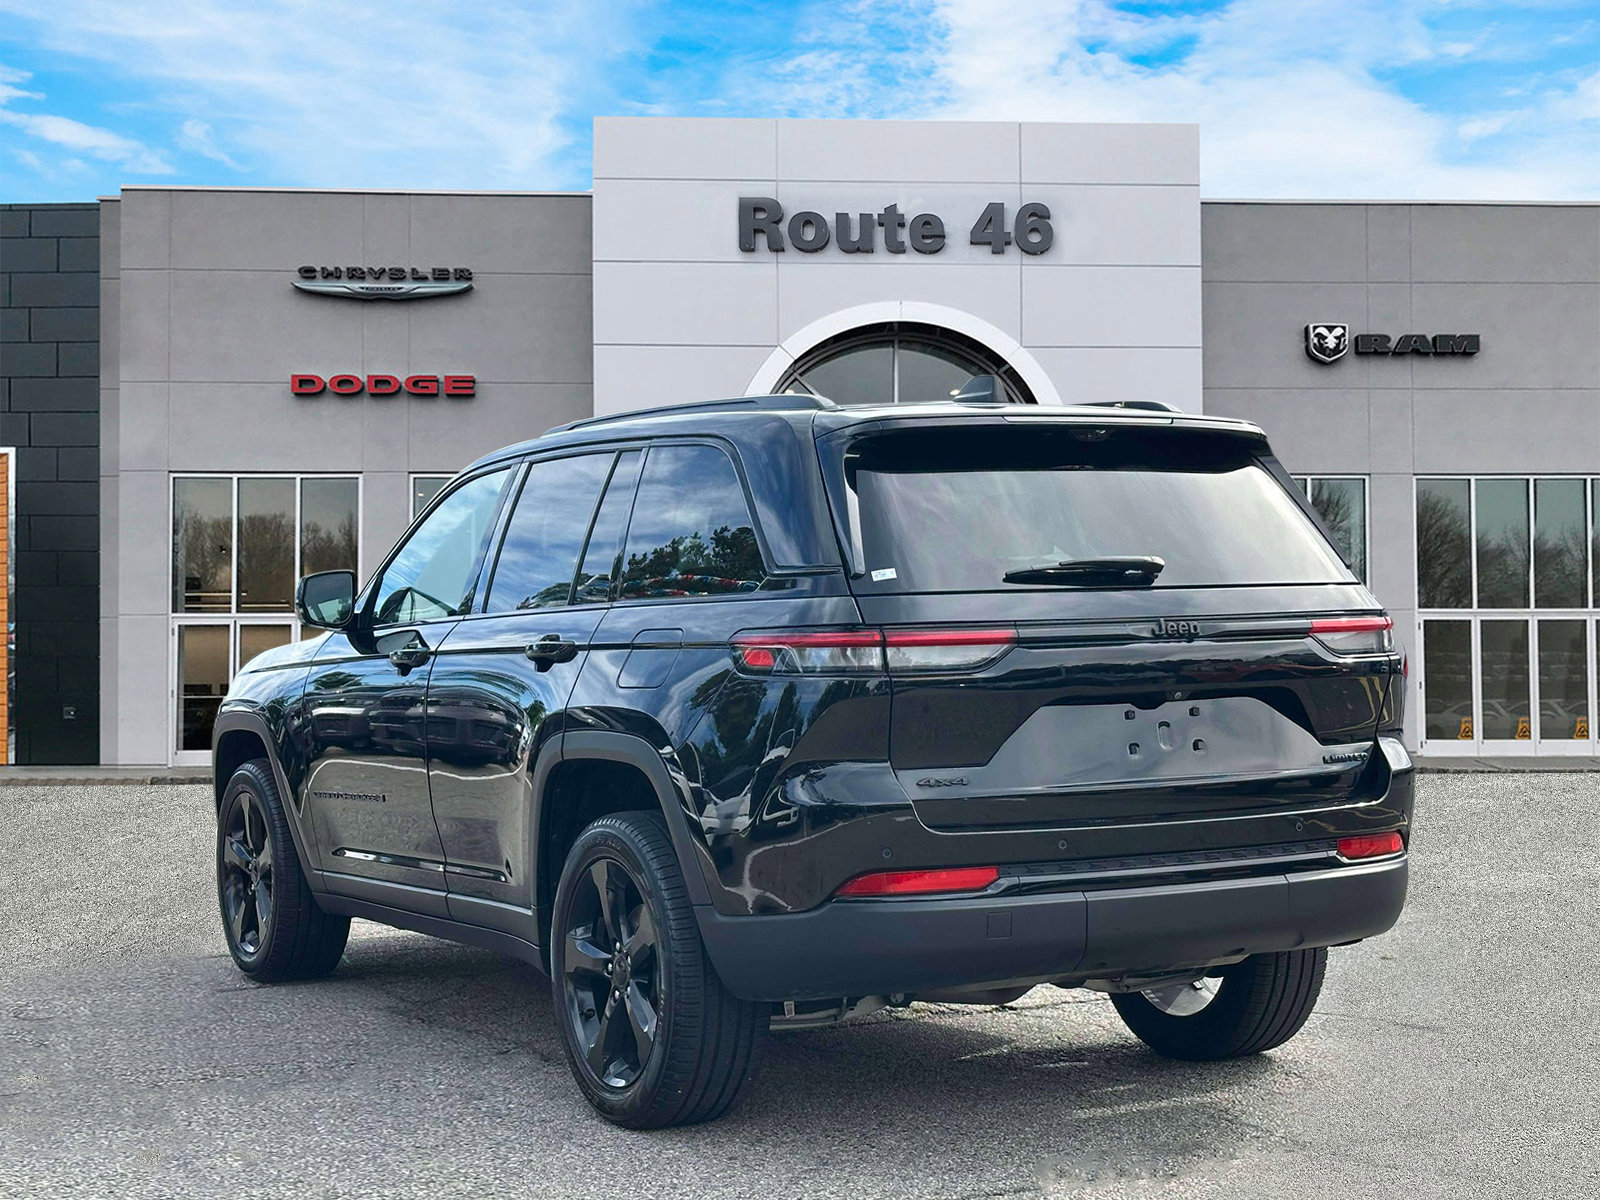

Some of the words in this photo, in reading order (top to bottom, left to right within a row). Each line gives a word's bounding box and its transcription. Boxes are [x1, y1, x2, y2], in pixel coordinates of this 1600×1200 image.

[738, 196, 946, 254] Route
[969, 201, 1054, 256] 46
[298, 266, 473, 281] CHRYSLER
[1354, 333, 1481, 356] RAM
[290, 373, 476, 397] DODGE
[1151, 617, 1200, 643] Jeep
